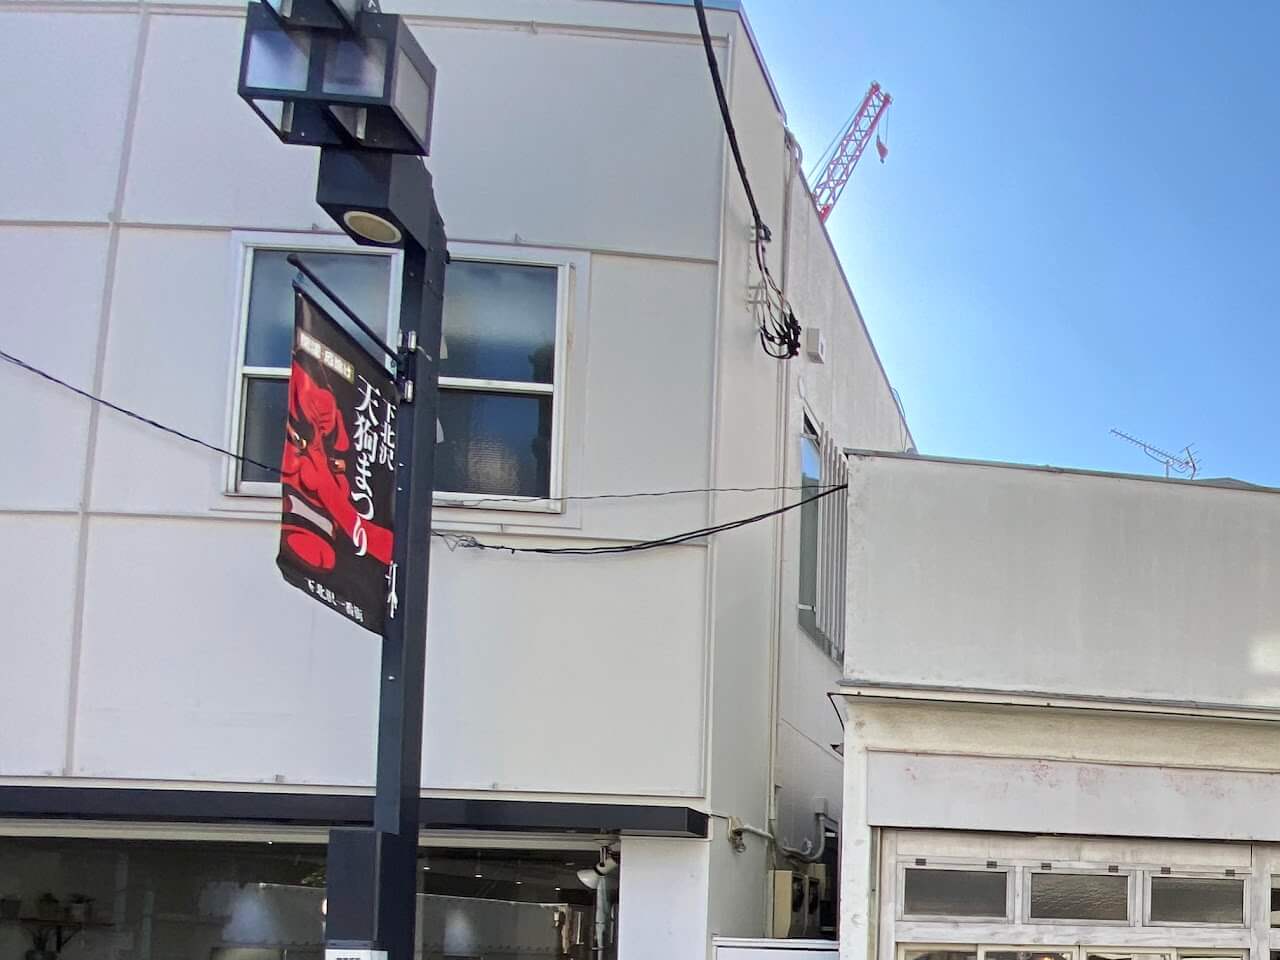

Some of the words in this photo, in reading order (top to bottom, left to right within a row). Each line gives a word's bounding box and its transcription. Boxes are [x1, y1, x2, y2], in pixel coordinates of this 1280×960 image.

[351, 374, 382, 557] 天狗まつり
[379, 398, 397, 471] 下北沢
